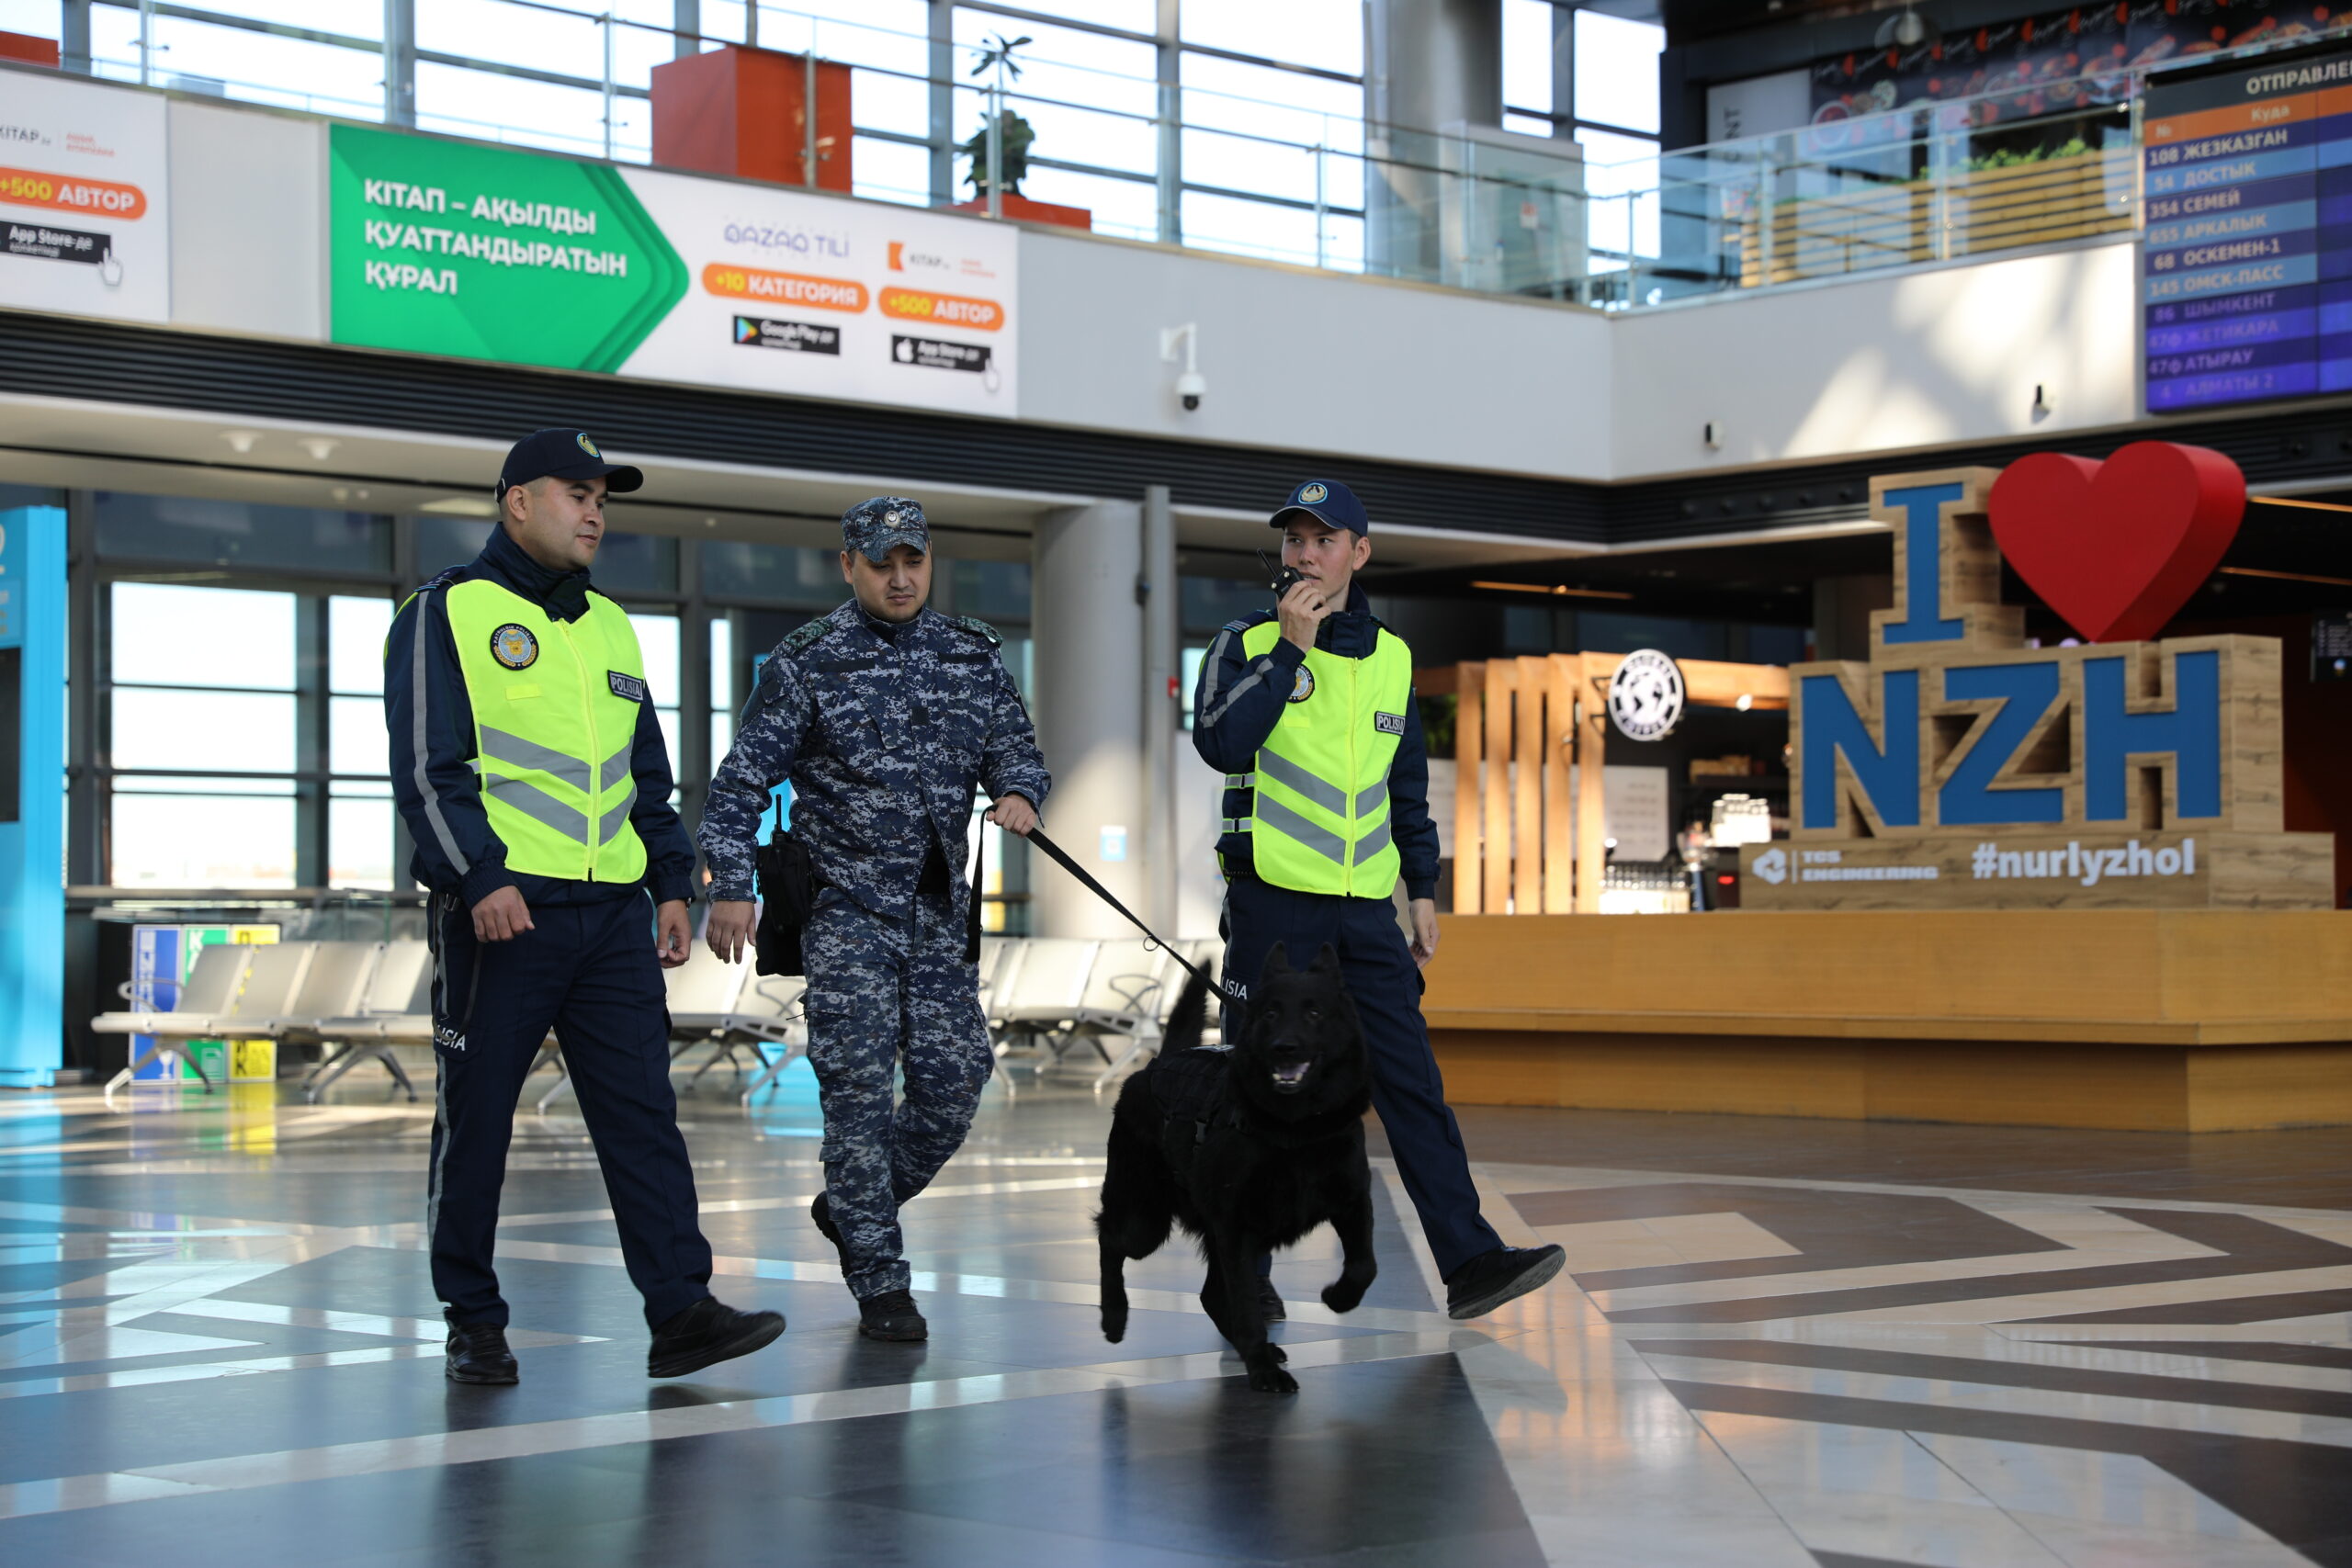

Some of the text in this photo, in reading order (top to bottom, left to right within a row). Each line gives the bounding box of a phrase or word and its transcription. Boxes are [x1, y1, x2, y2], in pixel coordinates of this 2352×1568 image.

[2246, 59, 2352, 95] ОТПРАВЛЕ
[2252, 105, 2290, 122] Куда
[2150, 129, 2288, 166] 108 ЖЕЗКАЗГАН
[2184, 161, 2256, 189] ДОСТЫК
[0, 176, 135, 211] +500 АВТОР
[365, 178, 446, 213] КІТАП
[471, 196, 595, 235] АҚЫЛДЫ
[2183, 187, 2240, 213] СЕМЕЙ
[9, 226, 37, 245] App
[2184, 213, 2267, 239] АРКАЛЫК
[365, 220, 628, 277] ҚУАТТАНДЫРАТЫН
[749, 274, 859, 306] КАТЕГОРИЯ
[2184, 265, 2284, 292] ОМСК-ПАСС
[933, 299, 996, 323] АВТОР
[2184, 293, 2277, 319] ШЫМКЕНТ
[2184, 348, 2255, 371] АТЫРАУ
[1883, 482, 1964, 645] I
[610, 676, 641, 696] POLISIA
[1801, 649, 2222, 829] NZH
[1802, 850, 1842, 863] TCS
[1973, 838, 2196, 886] #nurlyzhol
